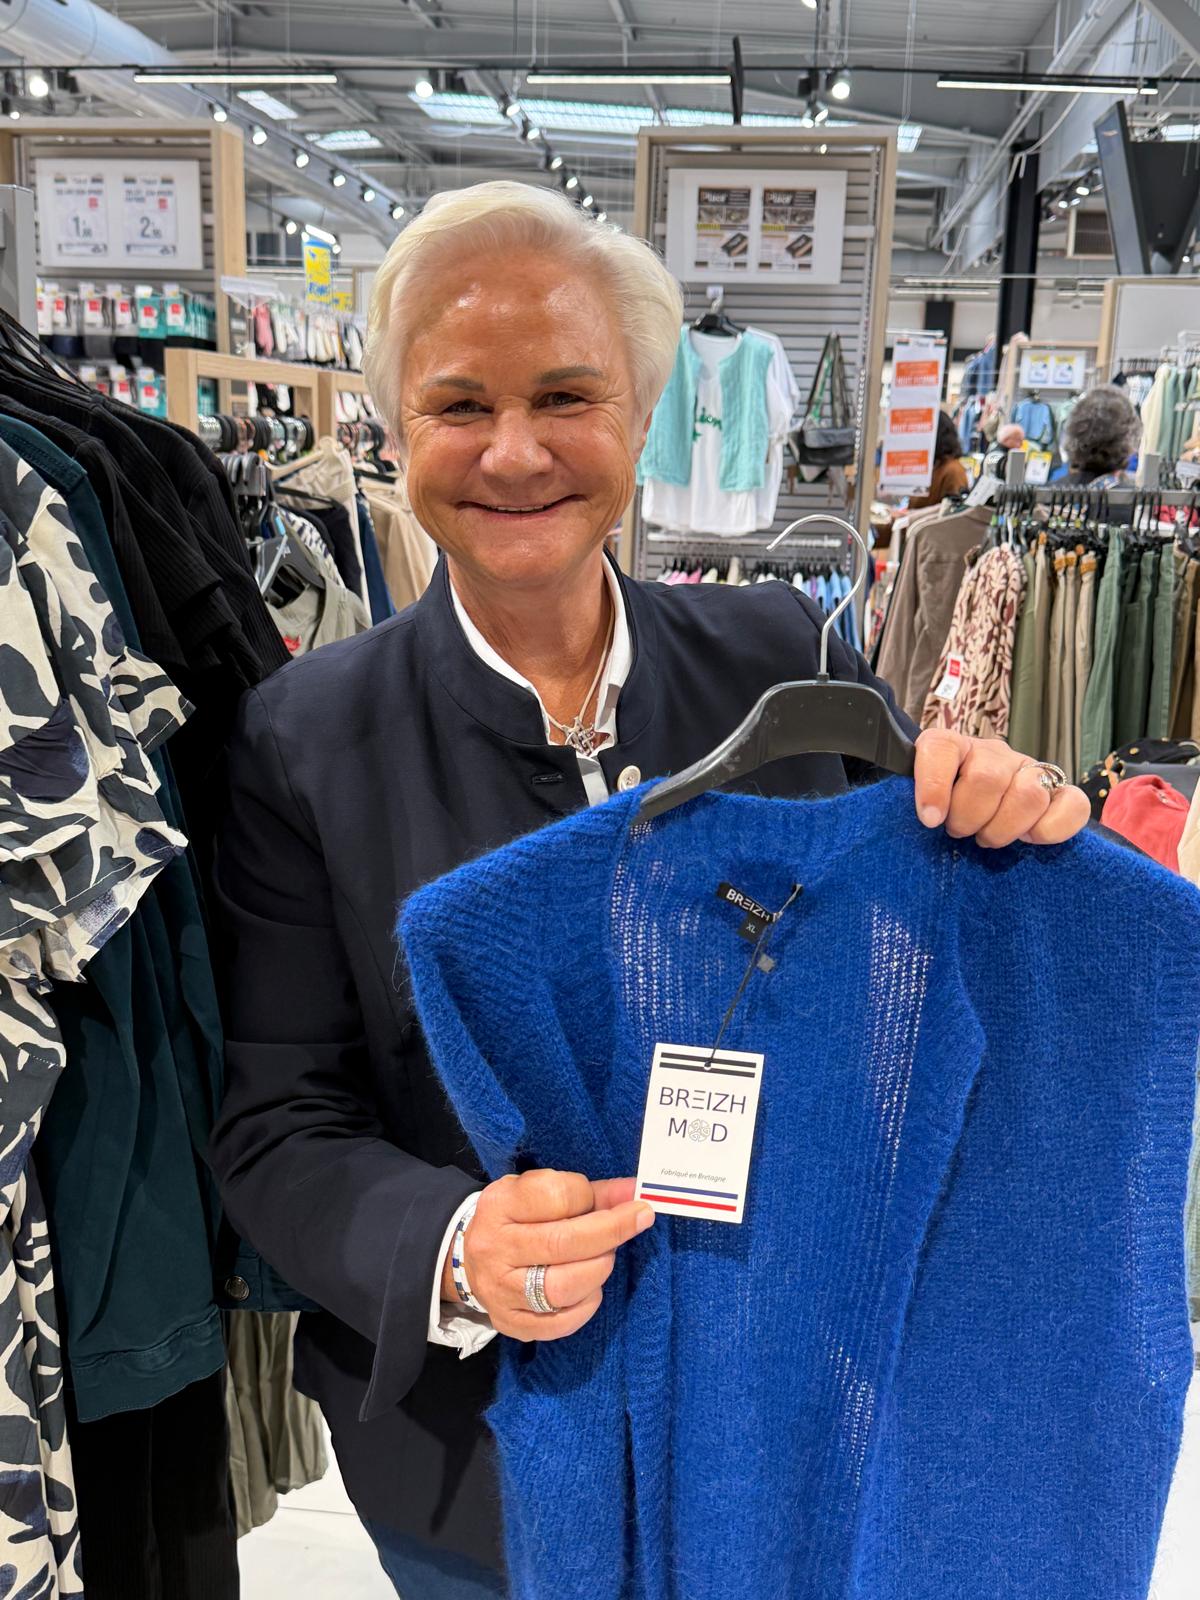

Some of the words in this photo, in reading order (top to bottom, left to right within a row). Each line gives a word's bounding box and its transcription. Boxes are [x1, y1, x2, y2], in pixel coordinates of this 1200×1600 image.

[726, 888, 770, 922] BREIZH
[746, 923, 756, 934] XL
[659, 1086, 747, 1115] BREIZH
[660, 1168, 688, 1178] Fabriqué
[697, 1173, 727, 1183] Bretagne
